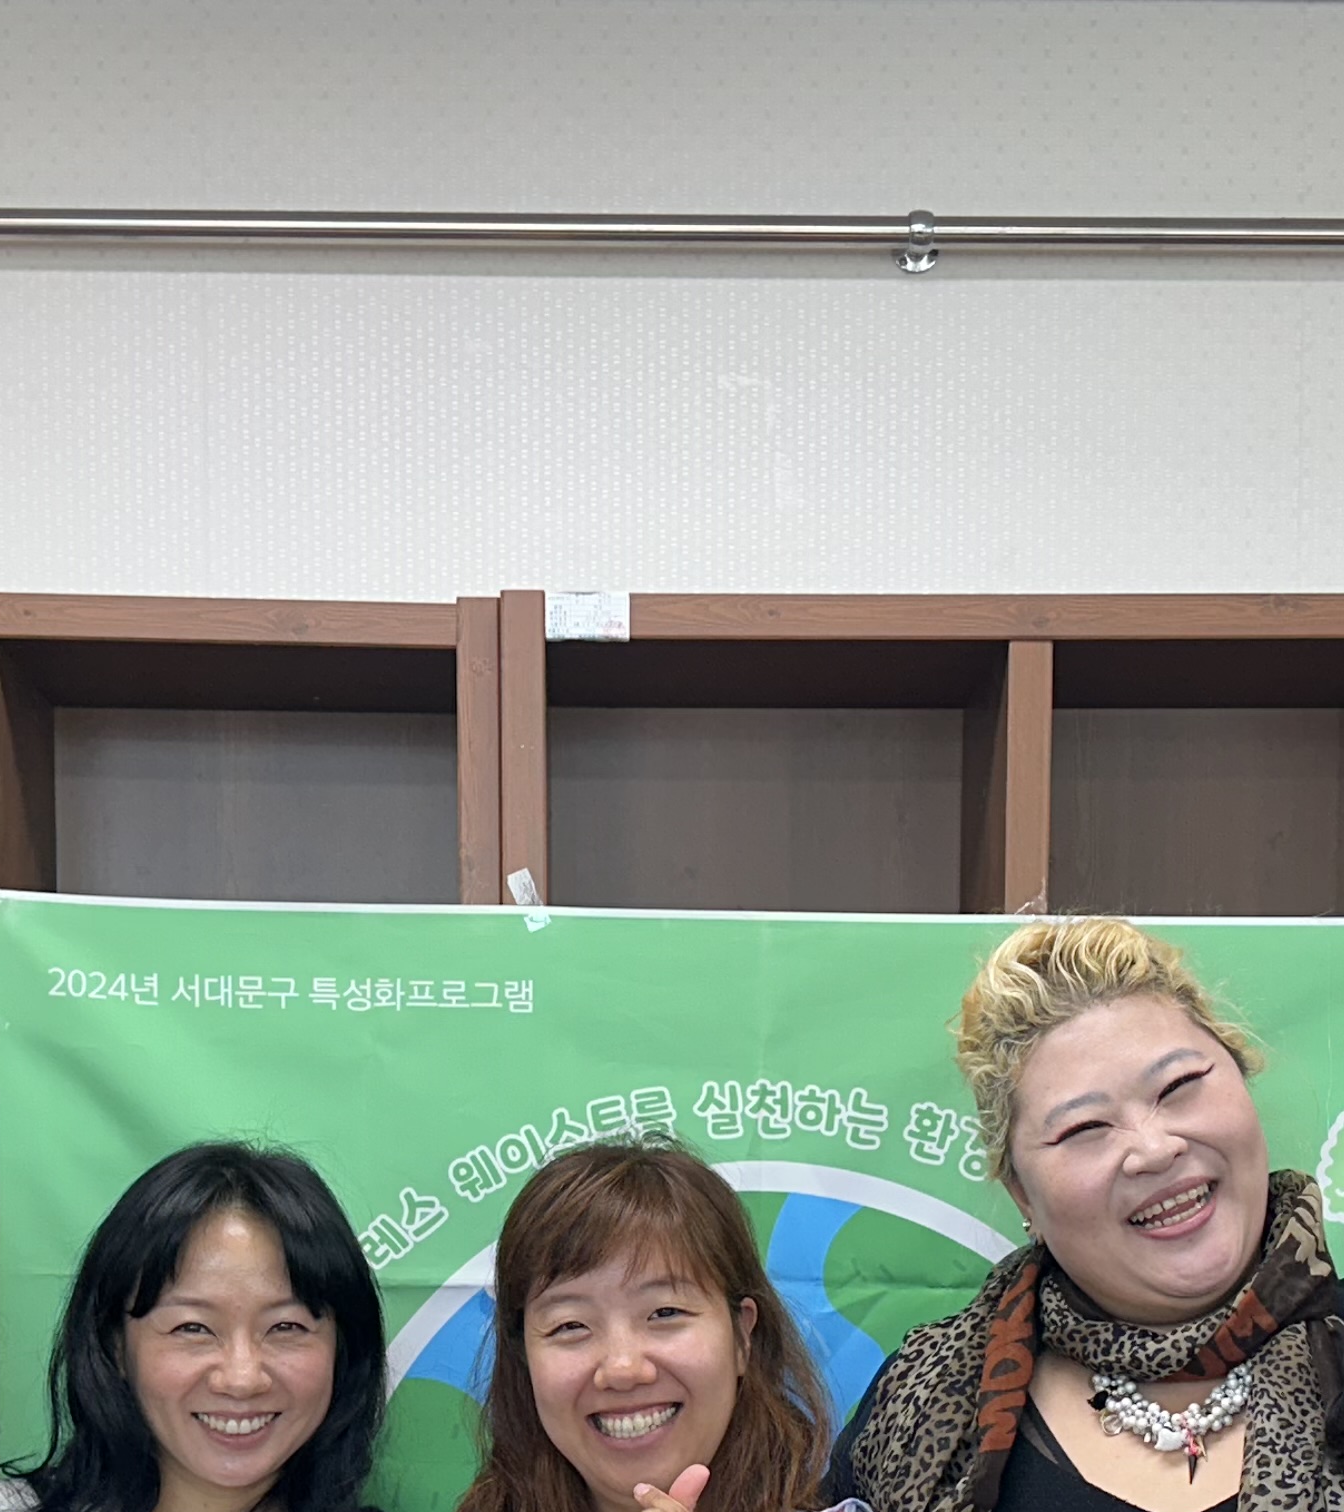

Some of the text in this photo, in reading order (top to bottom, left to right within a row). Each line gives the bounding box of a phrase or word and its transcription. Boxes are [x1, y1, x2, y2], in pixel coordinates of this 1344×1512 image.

[47, 966, 535, 1014] 2024년 서대문구 특성화프로그램
[693, 1078, 888, 1150] 실천하는
